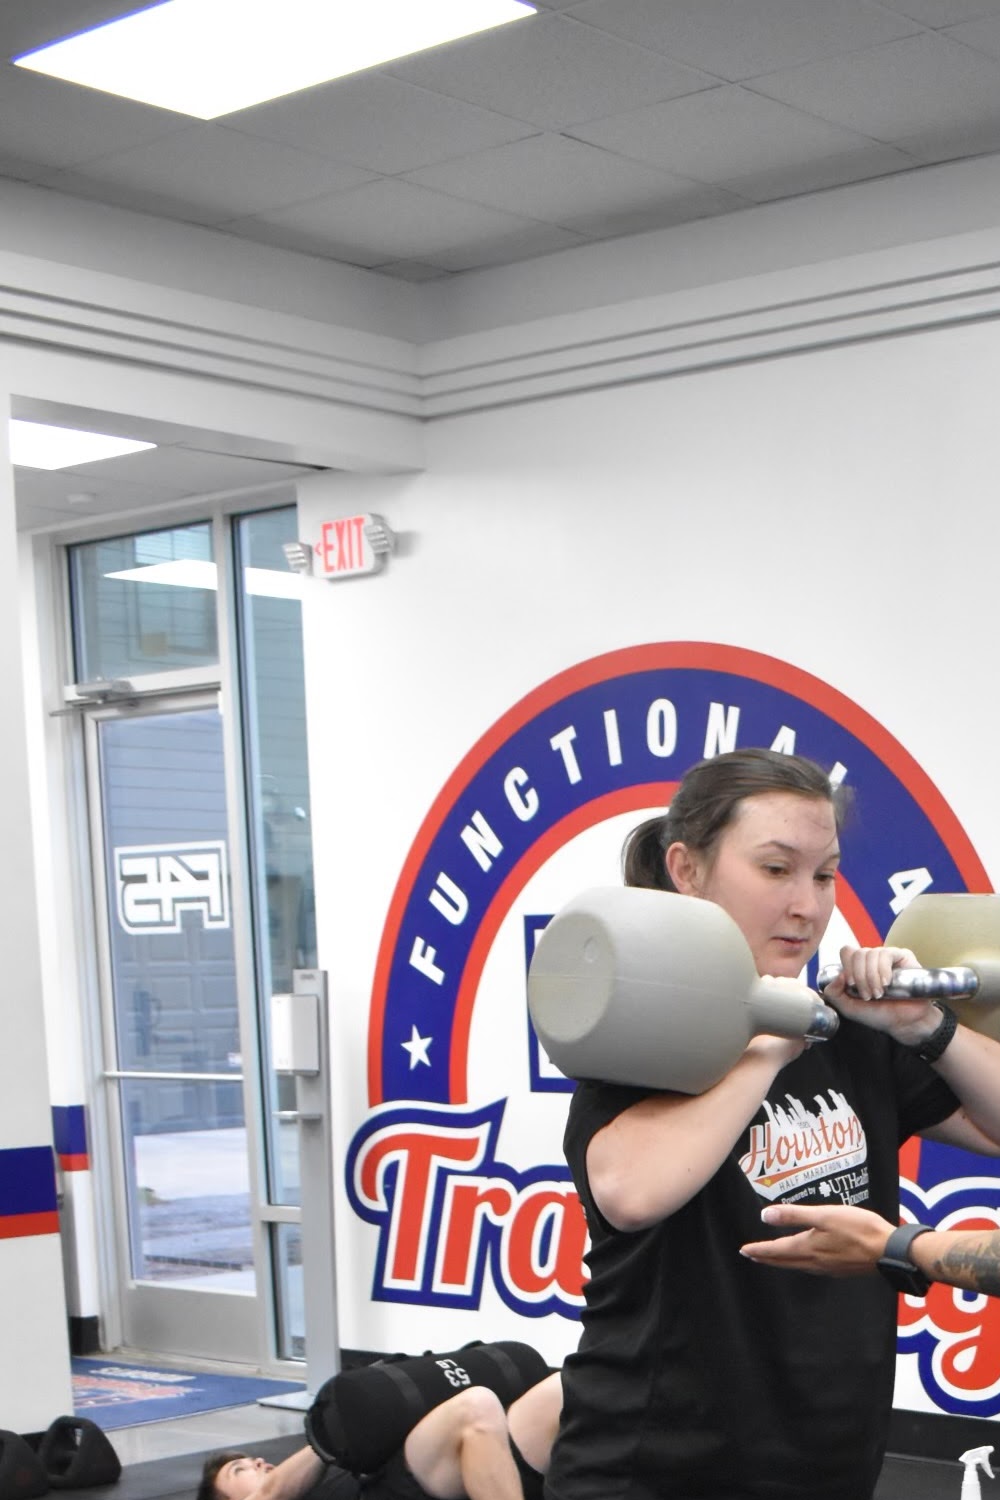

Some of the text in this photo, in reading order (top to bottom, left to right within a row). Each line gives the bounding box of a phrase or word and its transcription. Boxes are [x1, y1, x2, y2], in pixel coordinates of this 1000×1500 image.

[321, 516, 365, 573] EXIT
[739, 1115, 864, 1175] Houston
[779, 1176, 801, 1192] HALF
[802, 1161, 842, 1181] MARATHON
[434, 1358, 458, 1369] LB
[443, 1367, 471, 1388] 53
